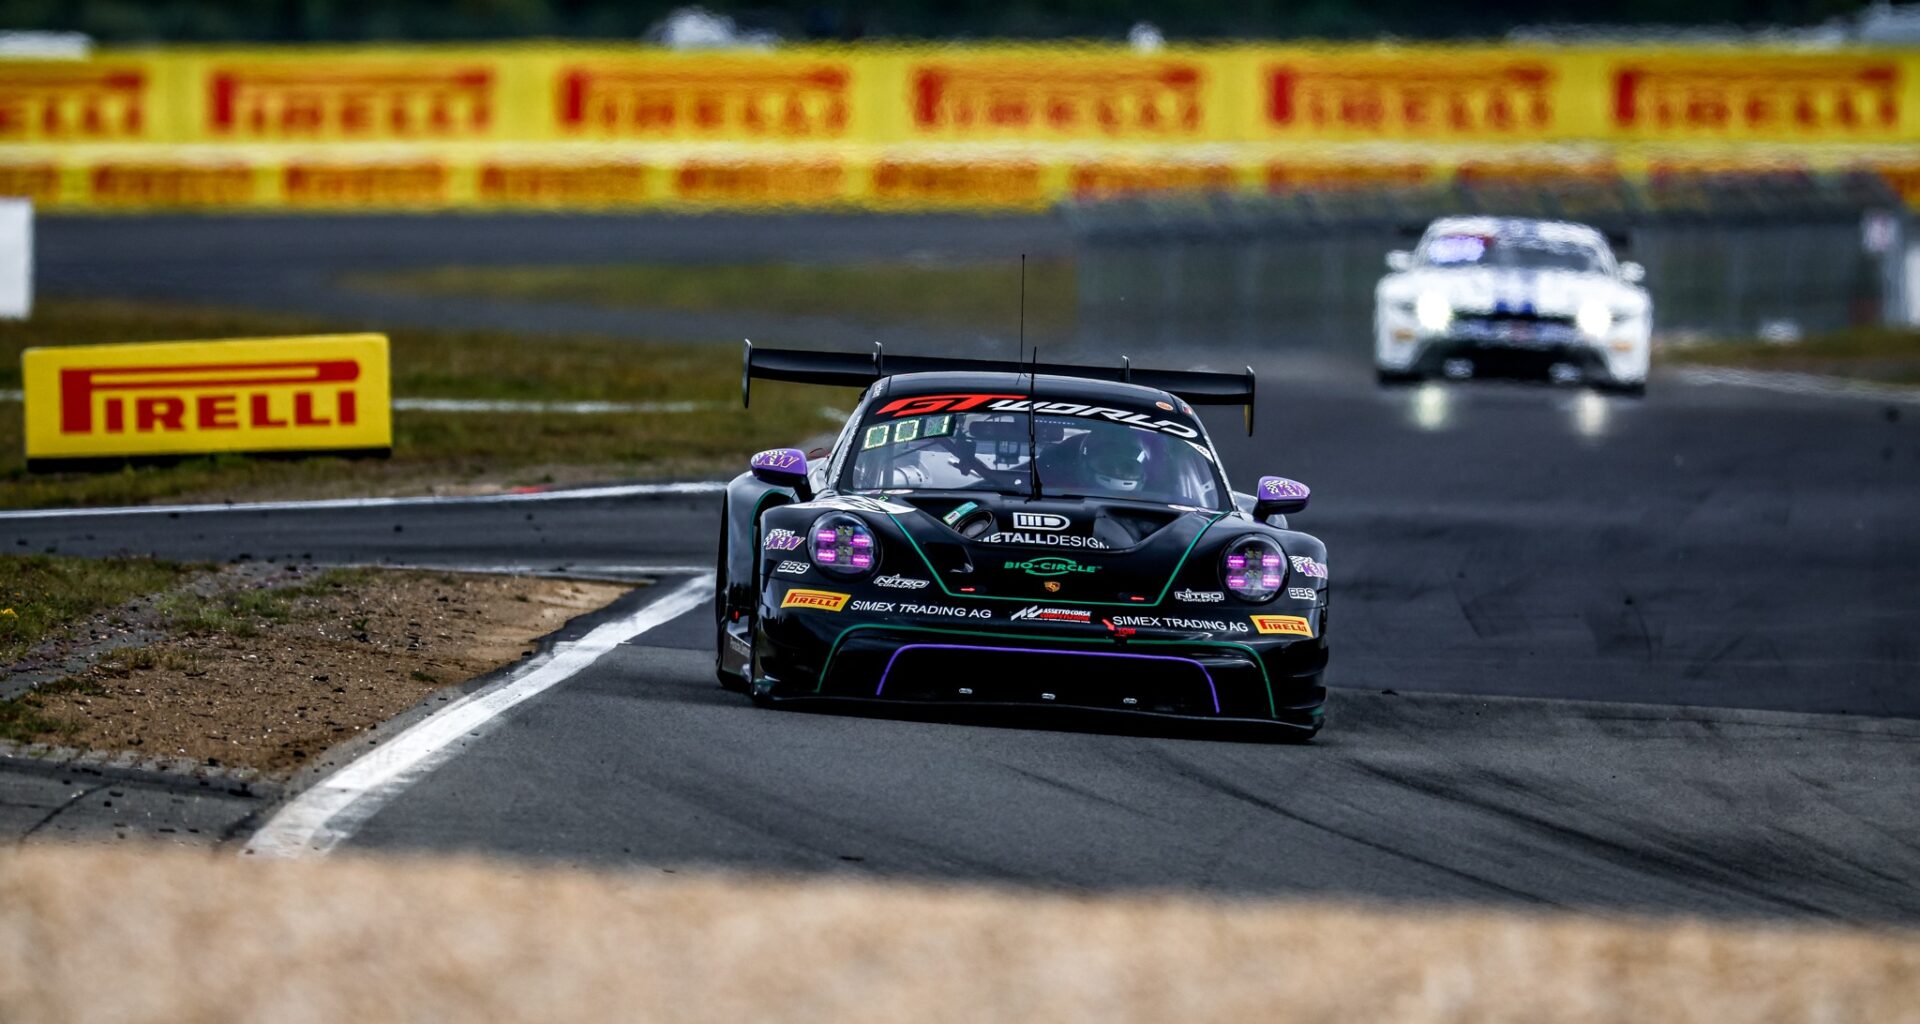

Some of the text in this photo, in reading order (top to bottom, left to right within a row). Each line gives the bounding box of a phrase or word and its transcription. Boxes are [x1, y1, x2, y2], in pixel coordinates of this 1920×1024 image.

[61, 359, 360, 434] PIRELLI
[754, 453, 799, 468] KW
[765, 534, 806, 550] KW
[777, 560, 810, 574] BBS
[873, 575, 929, 588] NITRO
[787, 592, 842, 608] PIRELLI
[1175, 590, 1224, 600] NITRO
[1288, 588, 1316, 600] BBS
[850, 600, 992, 618] SIMEX TRADING AG
[1112, 616, 1249, 632] SIMEX TRADING AG
[1259, 619, 1308, 633] PIRELLI
